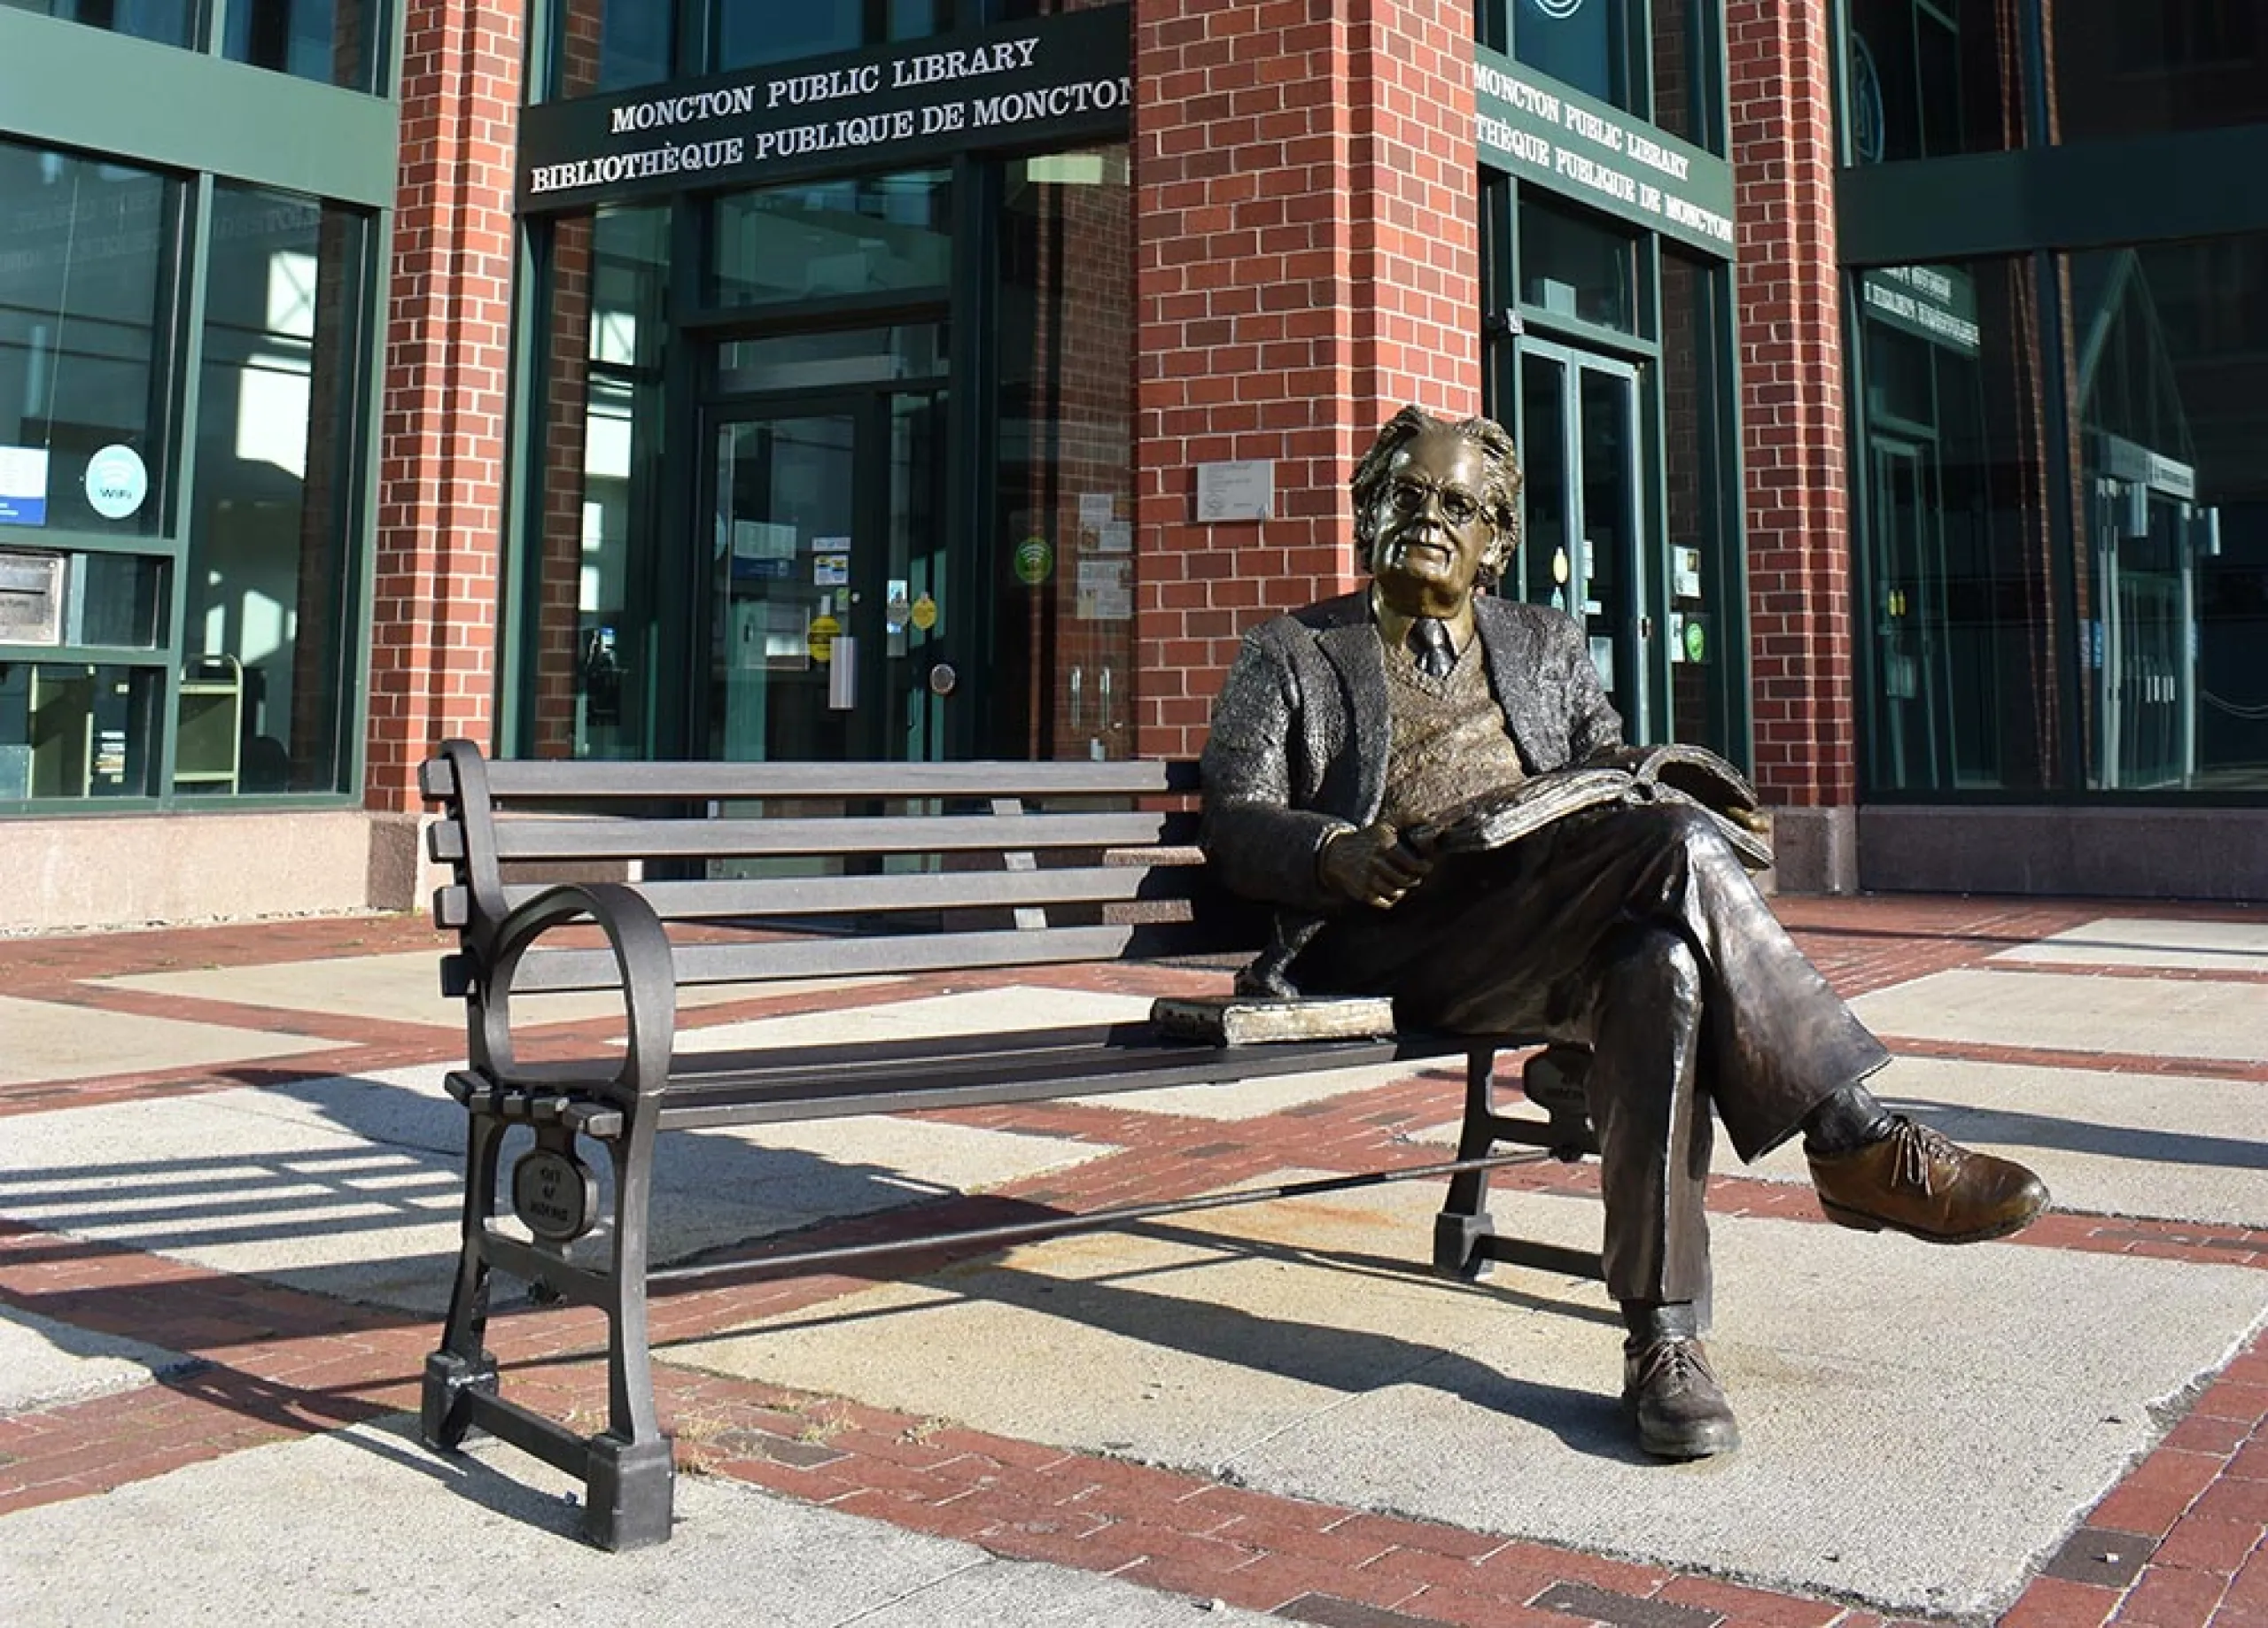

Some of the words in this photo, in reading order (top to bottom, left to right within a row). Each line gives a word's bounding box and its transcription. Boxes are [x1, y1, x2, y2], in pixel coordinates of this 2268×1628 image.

[610, 85, 756, 134] MONCTON
[766, 65, 880, 108] PUBLIC
[891, 36, 1040, 88] LIBRARY
[1474, 61, 1560, 123] MONCTON
[1564, 103, 1622, 151] PUBLIC
[1626, 131, 1689, 182] LIBRARY
[531, 139, 743, 193] BIBLIOTHÈQUE
[755, 110, 913, 159] PUBLIQUE
[920, 102, 964, 134] DE
[1555, 146, 1636, 203] PUBLIQUE
[1639, 182, 1661, 214] DE
